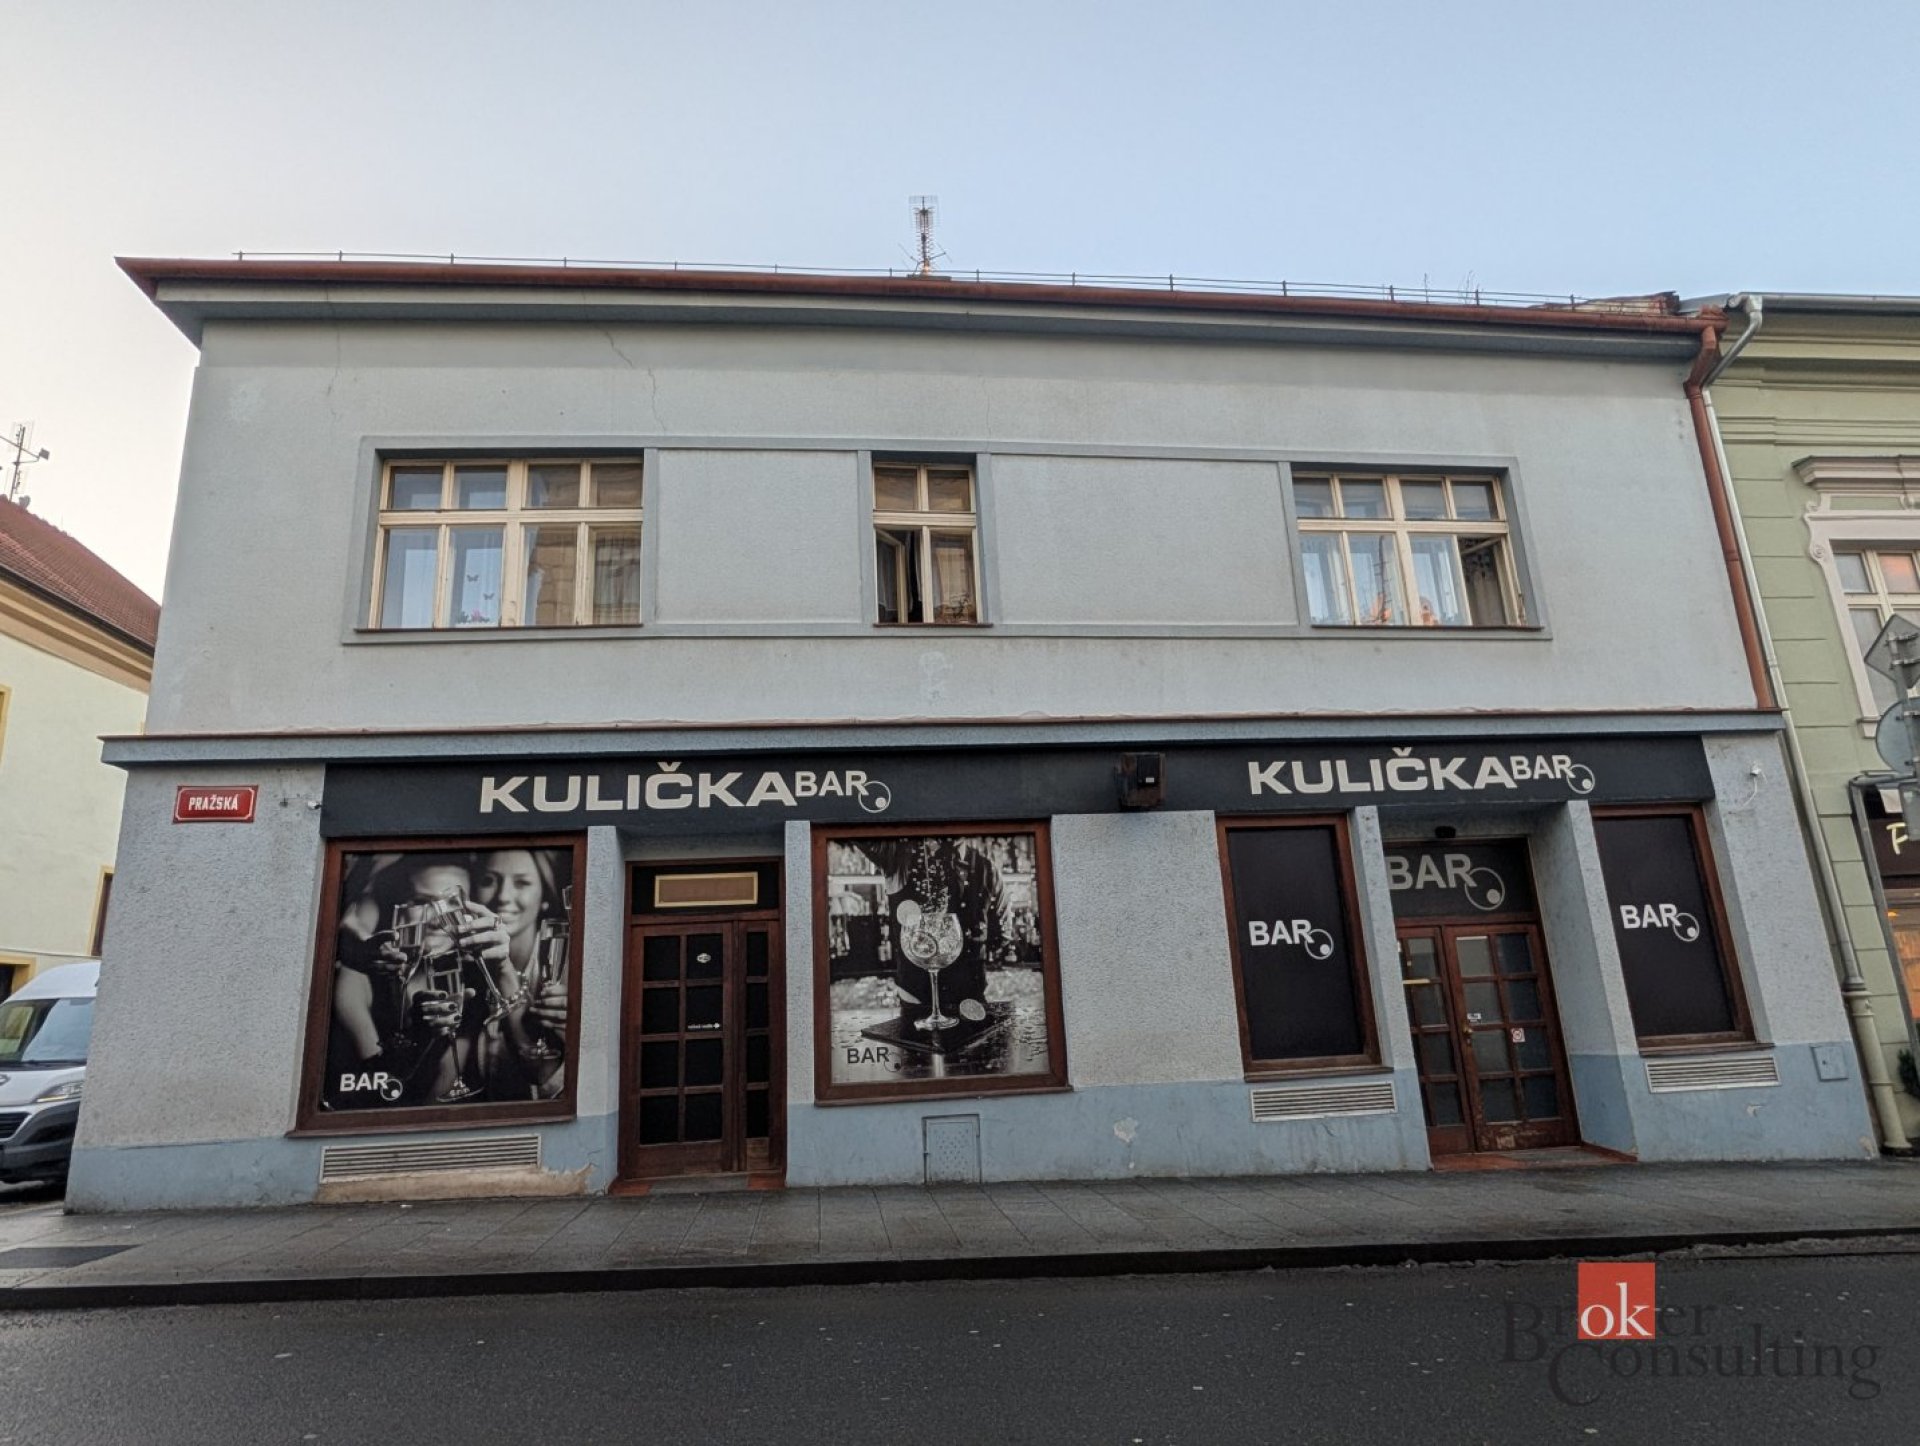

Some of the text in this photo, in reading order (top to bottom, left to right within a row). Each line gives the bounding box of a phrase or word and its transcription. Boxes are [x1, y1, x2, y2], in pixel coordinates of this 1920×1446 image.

[1248, 747, 1576, 795] KULIČKA BAR
[480, 761, 869, 813] KULIČKA BAR
[188, 793, 239, 811] PRAŽSKÁ
[1384, 853, 1478, 890] BAR
[1620, 903, 1682, 929] BAR
[1248, 919, 1315, 946] BAR
[846, 1046, 890, 1064] BAR
[339, 1071, 389, 1092] BAR
